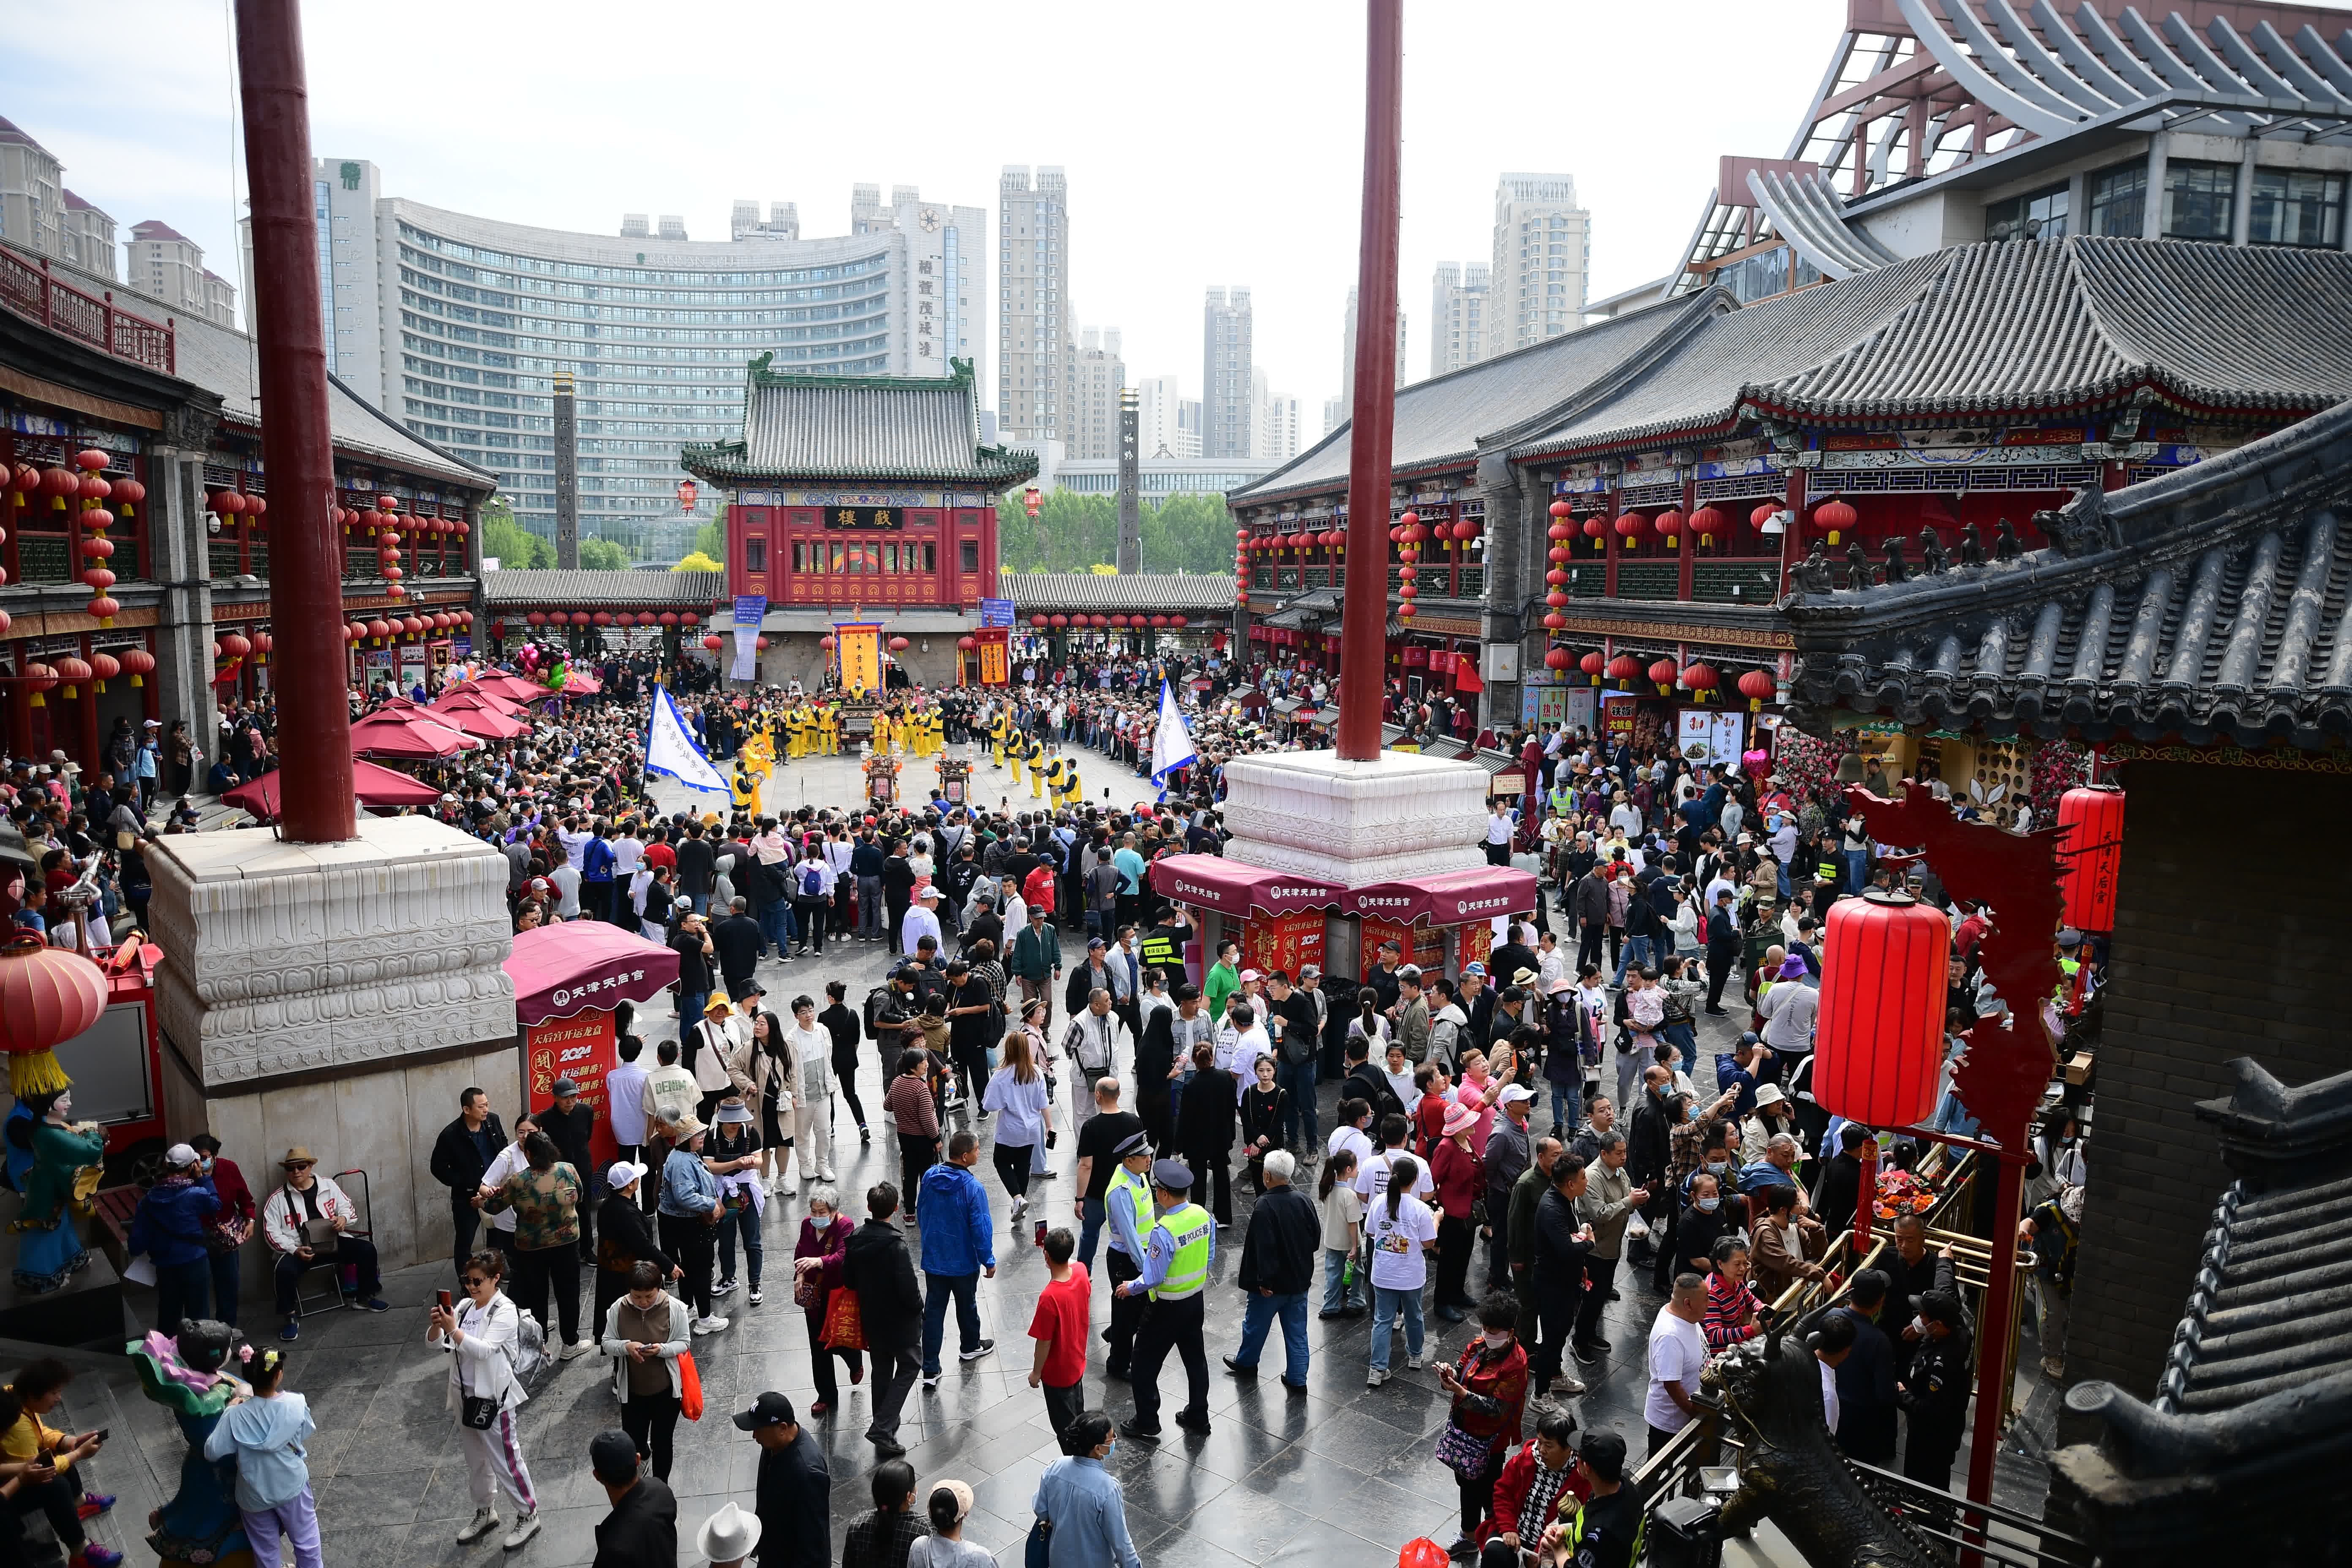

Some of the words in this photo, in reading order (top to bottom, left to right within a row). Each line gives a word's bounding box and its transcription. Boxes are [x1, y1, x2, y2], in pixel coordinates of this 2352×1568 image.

[1527, 691, 1537, 713] 冷饮
[1543, 703, 1562, 718] 热饮
[1611, 706, 1632, 717] 铁板
[1609, 720, 1633, 730] 大鱿鱼
[2096, 831, 2112, 904] 天津天后宫
[1184, 884, 1220, 900] 天津天后宫
[1282, 888, 1327, 896] 天津天后宫
[1368, 898, 1410, 906] 天津天后宫
[1468, 897, 1509, 910] 天津天后宫
[1301, 934, 1320, 946] 2024
[1757, 957, 1768, 967] 武
[572, 969, 645, 999] 天津天后宫
[532, 1025, 603, 1045] 天后宫开运龙盒
[559, 1045, 593, 1062] 2024
[1187, 1228, 1203, 1242] POLICE
[1202, 1224, 1209, 1236] 察
